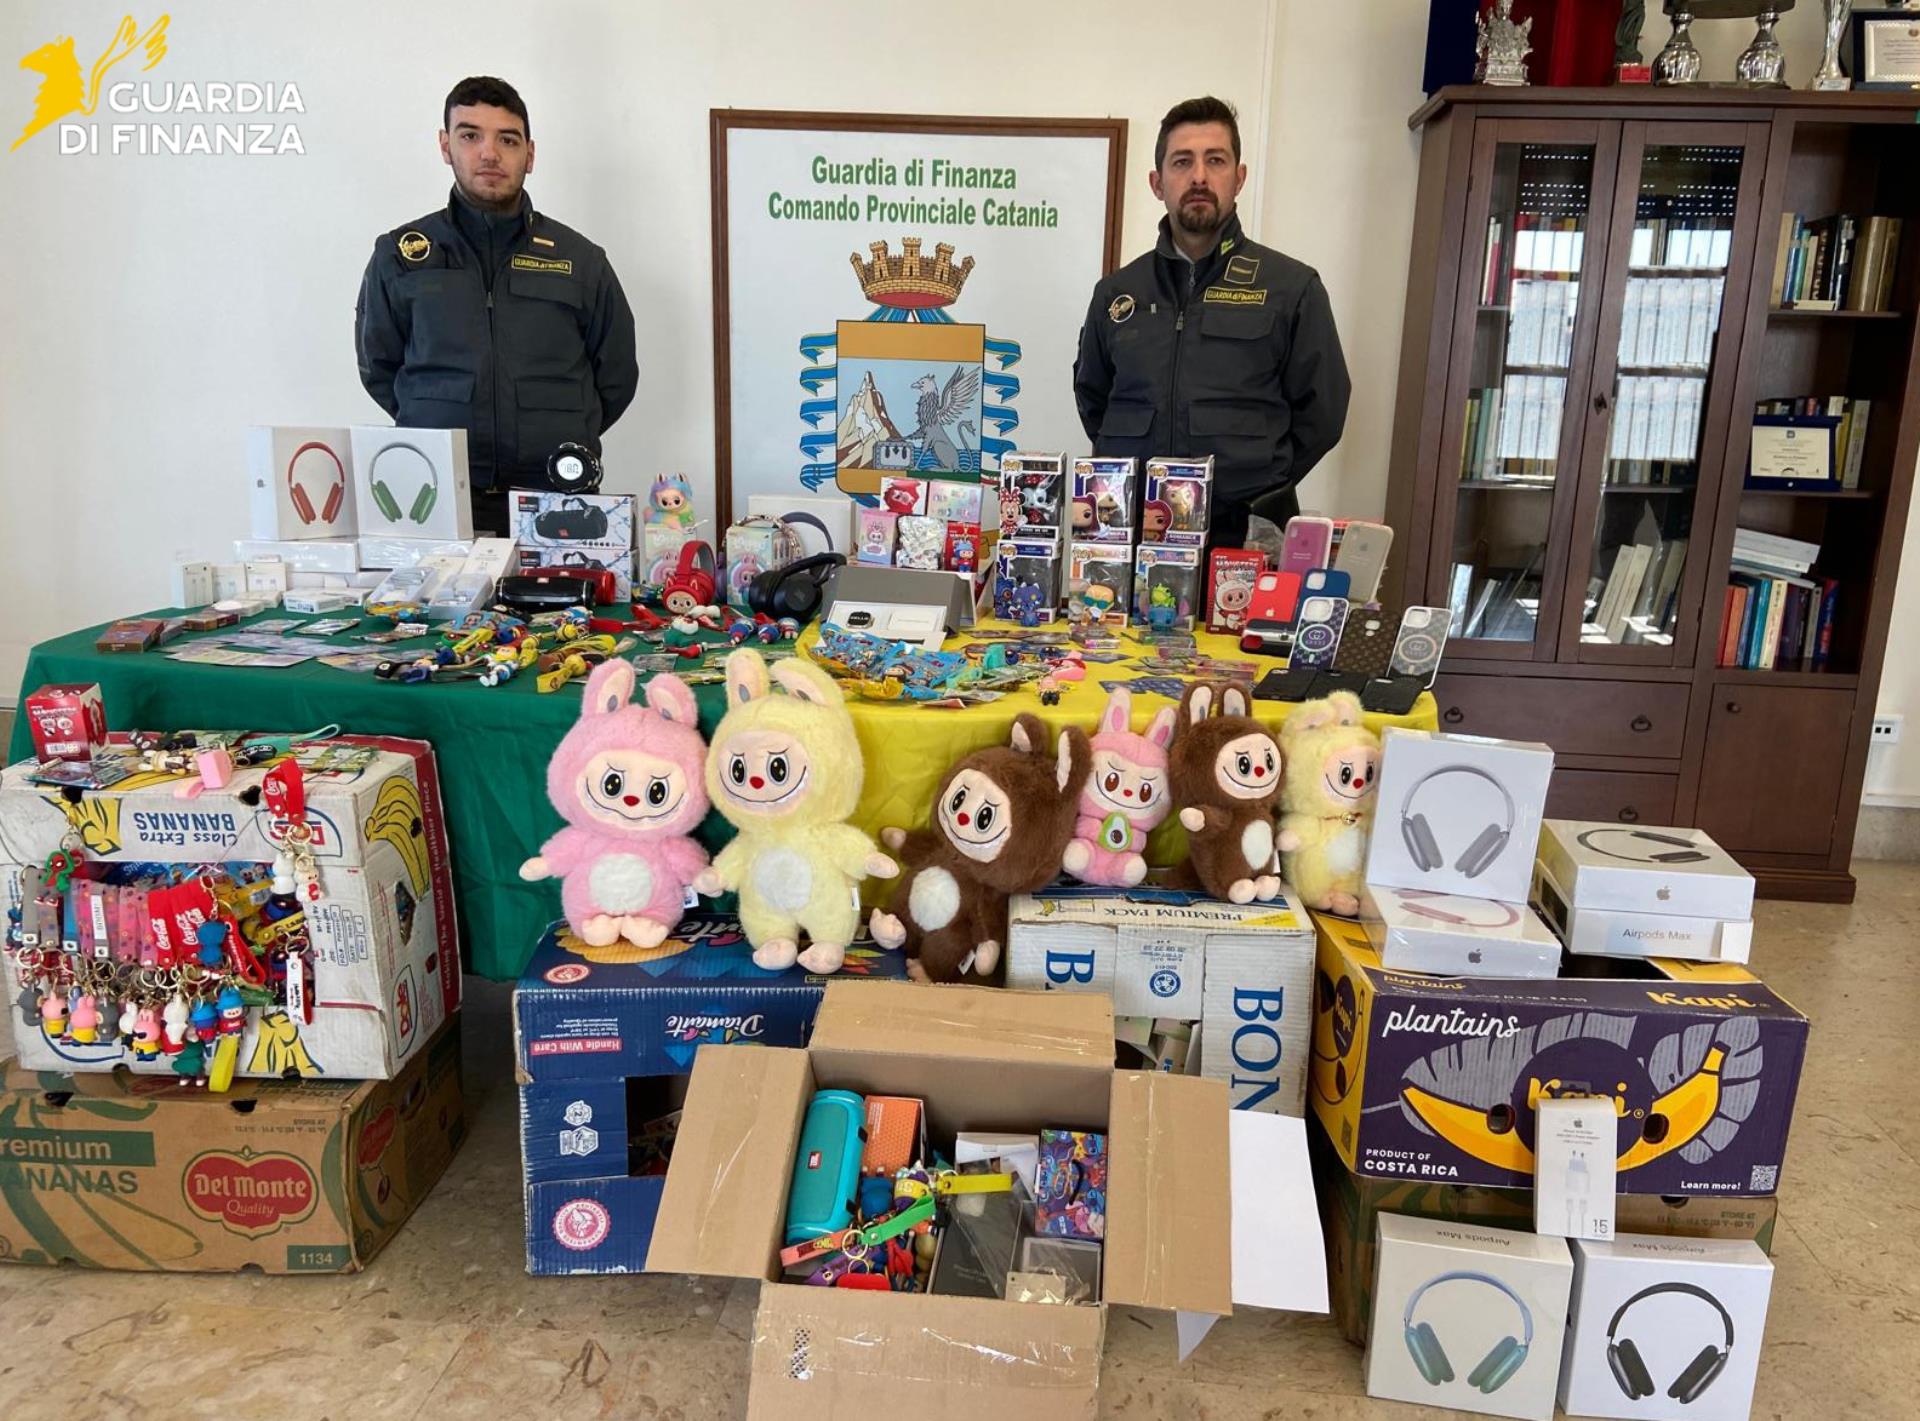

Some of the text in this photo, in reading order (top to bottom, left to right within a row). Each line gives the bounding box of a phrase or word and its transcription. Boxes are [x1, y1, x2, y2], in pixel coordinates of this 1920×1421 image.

[811, 155, 1017, 190] Guardia di Finanza
[768, 191, 1059, 229] Comando Provinciale Catania
[421, 780, 432, 813] Place
[133, 812, 235, 832] BANANAS
[139, 831, 238, 847] Class Extra
[1103, 907, 1243, 922] PREMIUM PACK
[439, 924, 448, 945] The
[1622, 928, 1692, 941] Airpods Max
[1383, 974, 1467, 992] plantains
[1645, 990, 1757, 1010] Kapi
[664, 1013, 764, 1038] Diamante
[1381, 1004, 1521, 1039] plantains
[533, 1039, 620, 1053] Handle With Care
[0, 1134, 112, 1161] remium
[1365, 1148, 1432, 1161] PRODUCT OF
[1364, 1159, 1459, 1177] COSTA RICA
[2, 1166, 139, 1195] ANANAS
[194, 1172, 308, 1200] Del Monte
[1681, 1180, 1741, 1191] Learn more!
[225, 1199, 275, 1218] Quality
[1434, 1229, 1511, 1247] Airpods Max
[1631, 1241, 1658, 1252] Max
[298, 1252, 334, 1266] 1134
